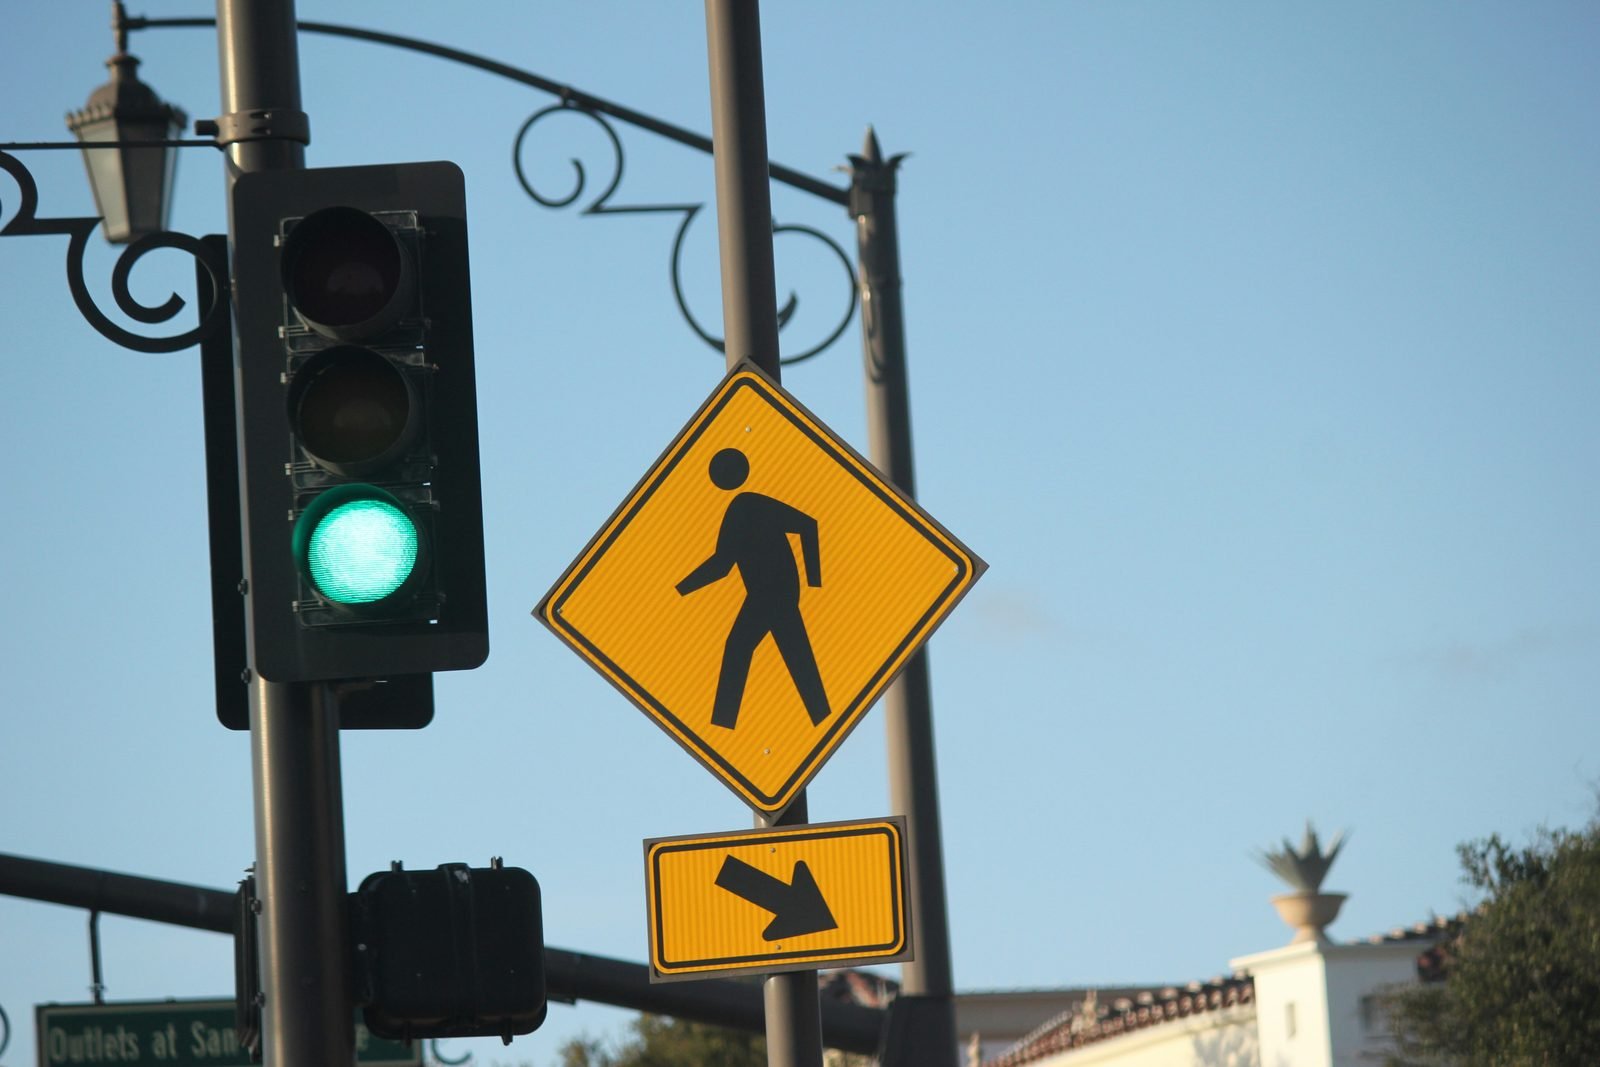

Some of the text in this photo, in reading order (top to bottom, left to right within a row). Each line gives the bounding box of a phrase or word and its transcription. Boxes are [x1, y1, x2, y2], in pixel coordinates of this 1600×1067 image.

[51, 1020, 239, 1062] Outlets at San
